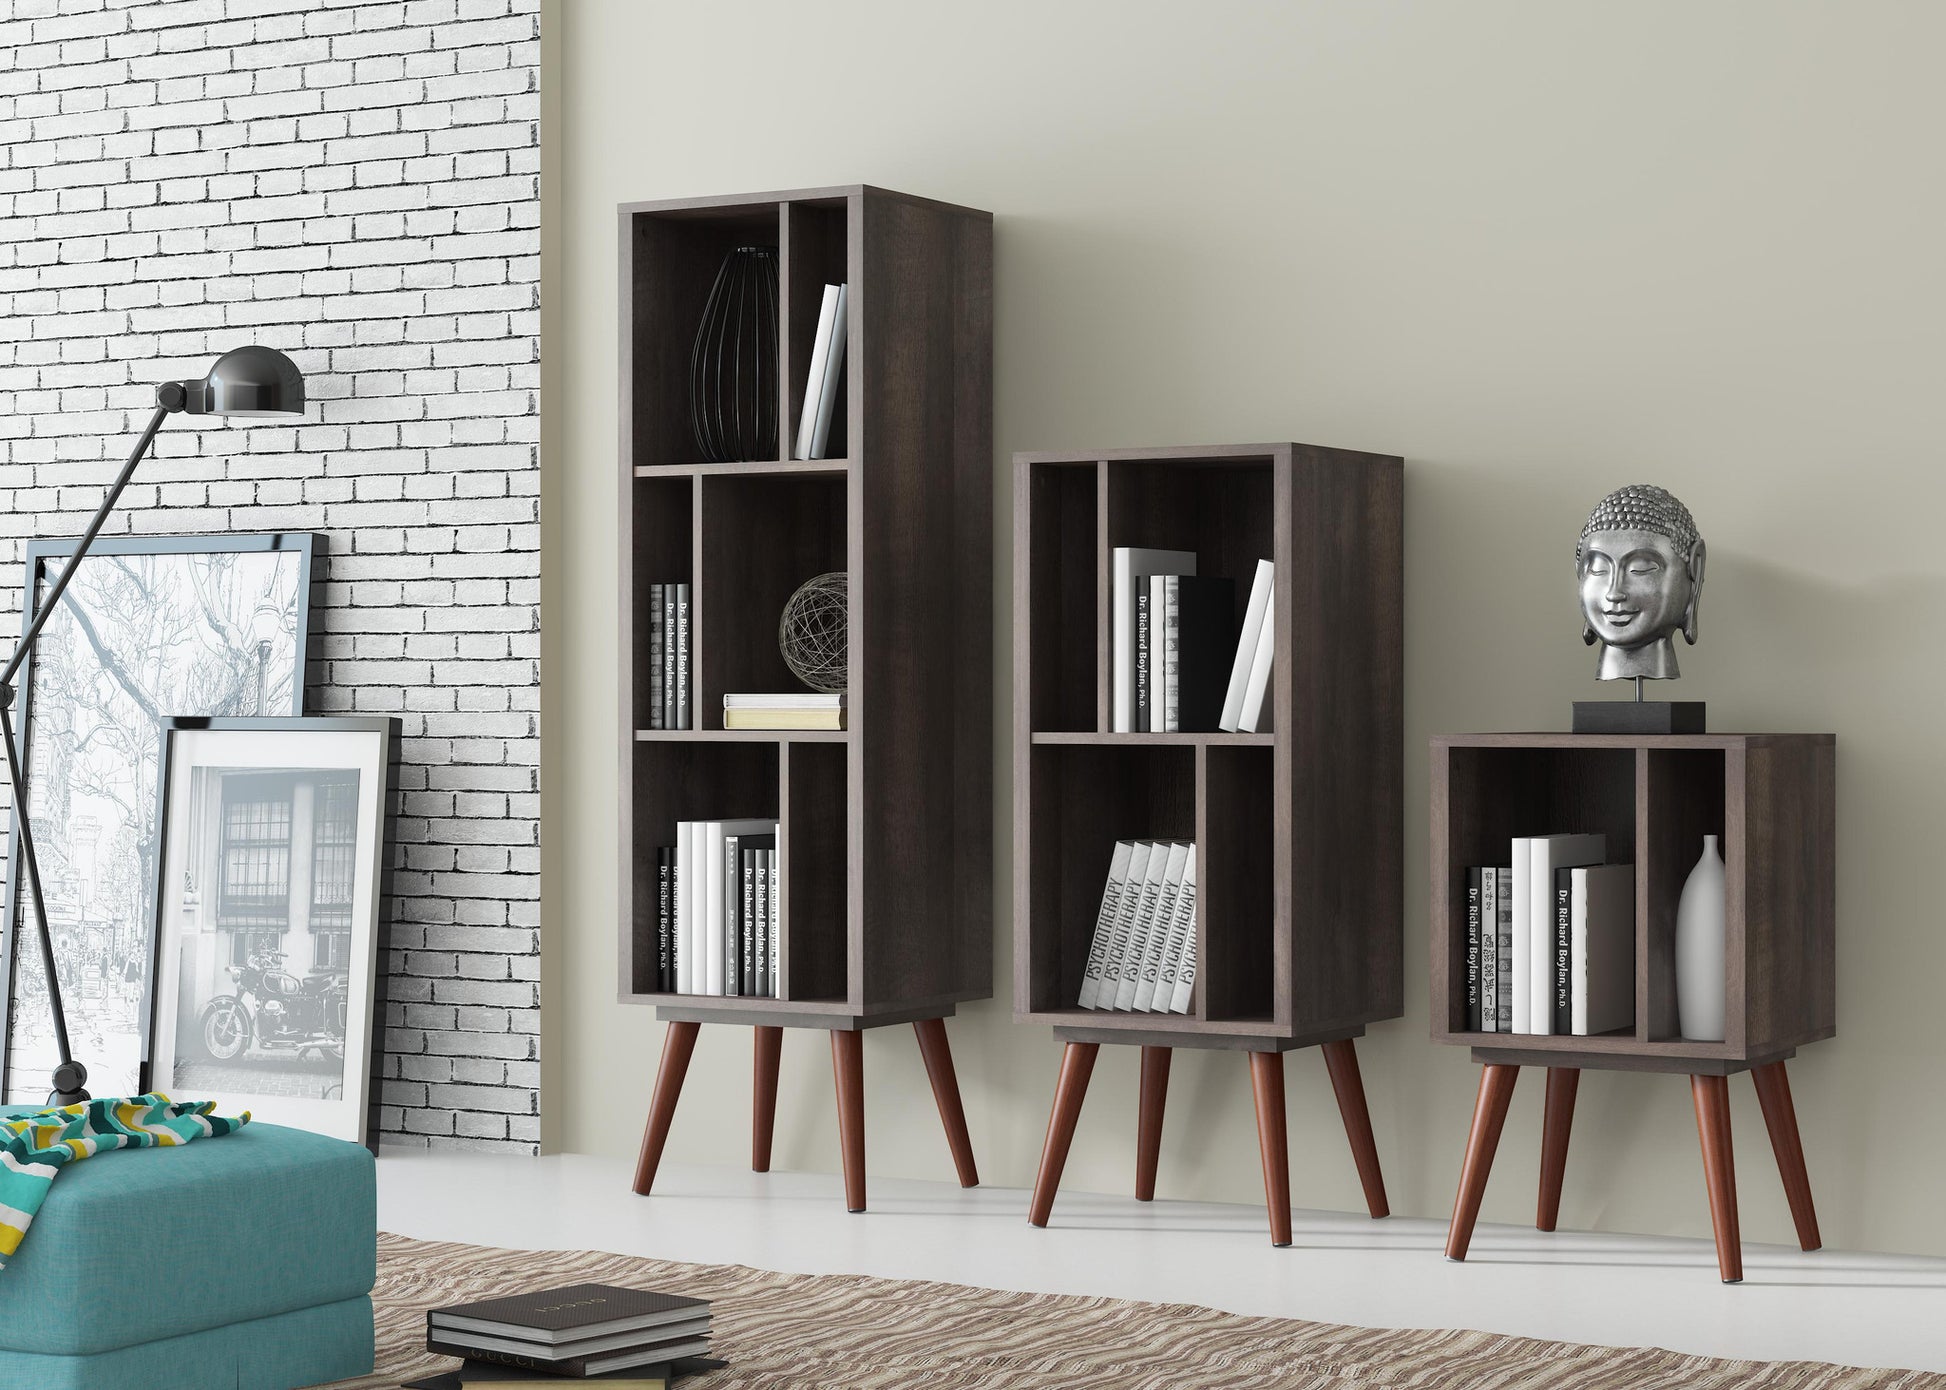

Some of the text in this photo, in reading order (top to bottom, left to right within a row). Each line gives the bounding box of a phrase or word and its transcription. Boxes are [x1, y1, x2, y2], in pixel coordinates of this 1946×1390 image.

[666, 603, 674, 615] Dr.
[679, 603, 687, 615] Dr.
[666, 618, 675, 653] Richard
[679, 618, 688, 653] Richard
[1136, 596, 1148, 709] Dr. Richard Boylan, Ph.D.
[665, 655, 675, 688] Boylan,
[678, 655, 688, 688] Boylan,
[660, 866, 668, 878] Dr.
[758, 868, 766, 881] Dr.
[660, 881, 668, 915] Richard
[745, 884, 753, 918] Richard
[758, 884, 766, 919] Richard
[1469, 888, 1478, 902] Dr.
[659, 917, 668, 951] Boylan,
[743, 921, 753, 954] Boylan,
[757, 921, 766, 955] Boylan,
[1085, 877, 1123, 981] PSYCHOTHERAPY
[1104, 877, 1141, 982] PSYCHOTHERAPY
[1122, 878, 1160, 983] PSYCHOTHERAPY
[1141, 879, 1179, 983] PSYCHOTHERAPY
[1159, 880, 1196, 984] PSYCHOTHERAPY
[1469, 905, 1478, 944] Richard
[1467, 947, 1478, 984] Boylan,
[1556, 889, 1568, 1009] Dr. Richard Boylan, Ph.D.
